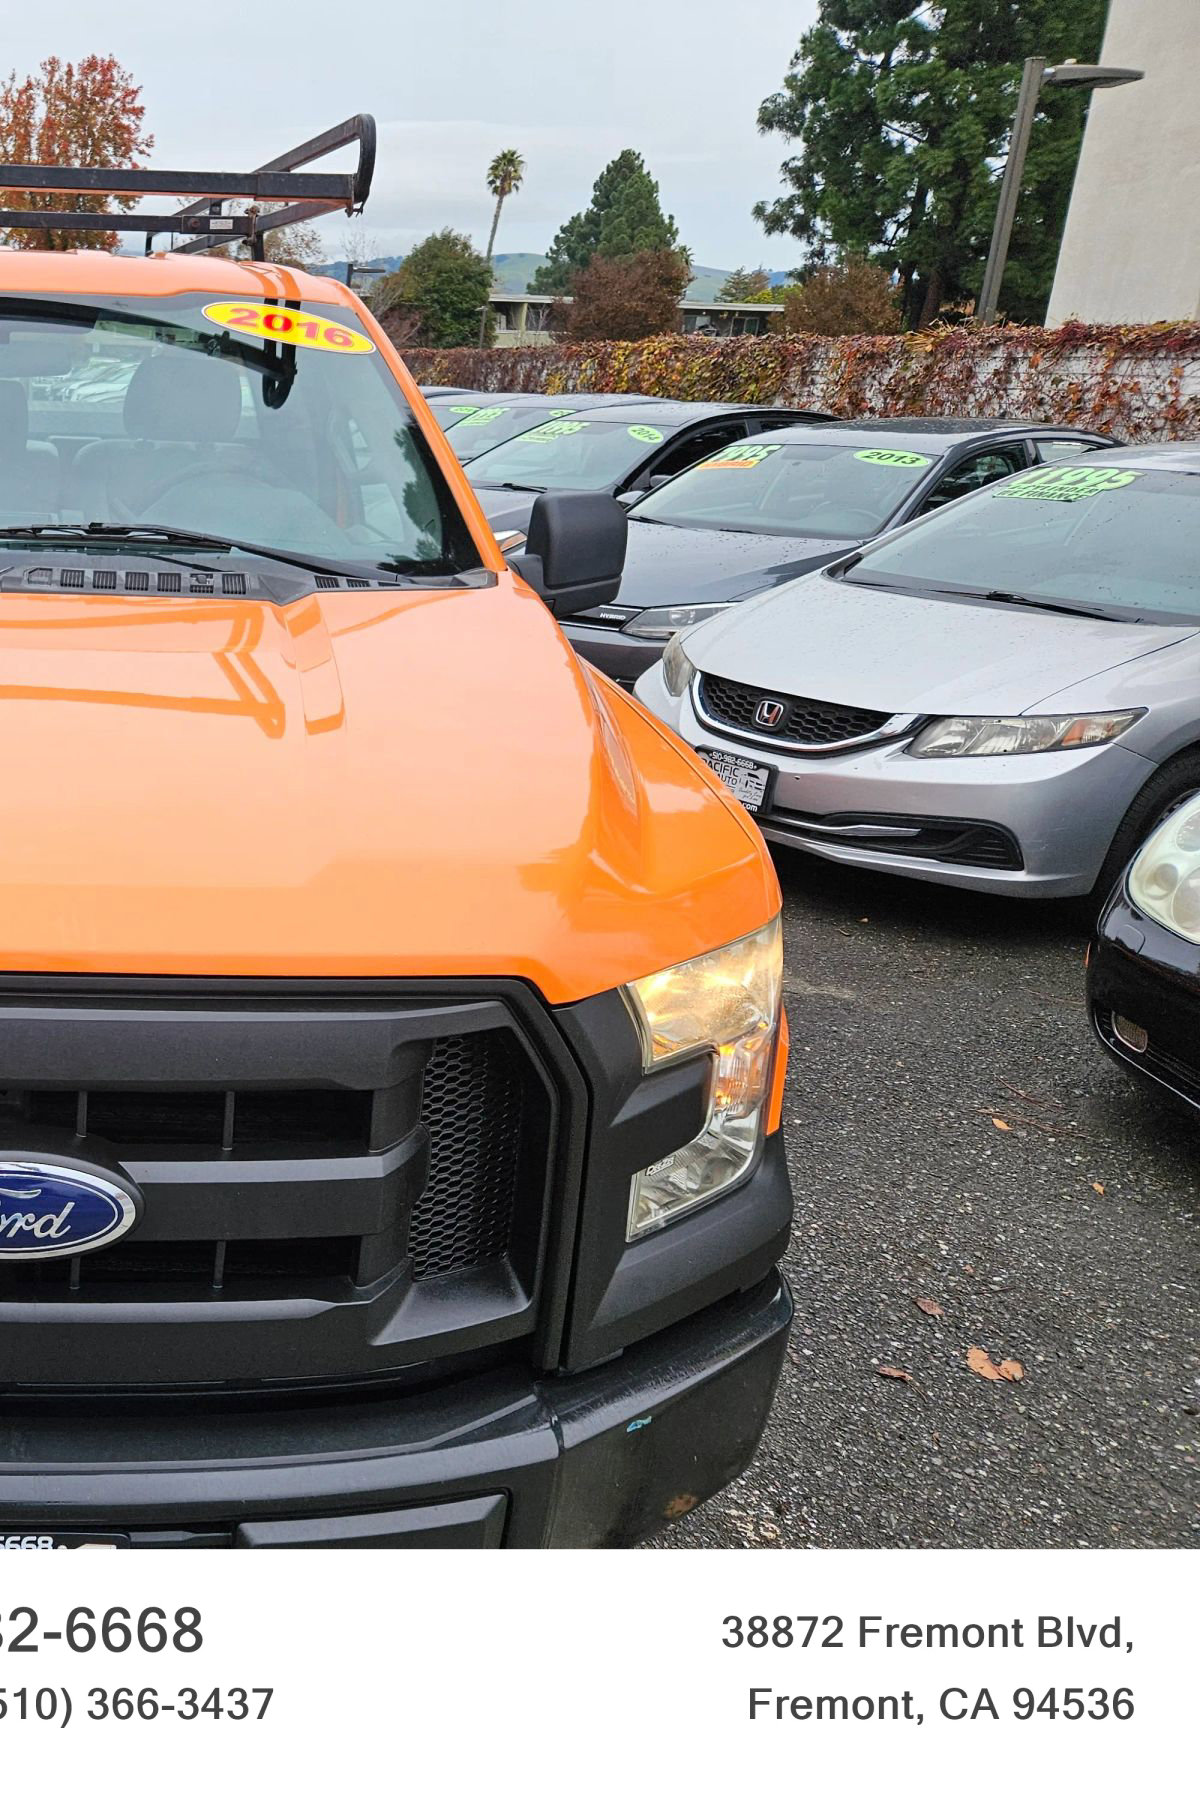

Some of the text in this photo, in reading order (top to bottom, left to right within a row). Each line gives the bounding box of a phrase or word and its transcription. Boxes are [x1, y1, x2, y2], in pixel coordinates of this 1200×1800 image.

[227, 307, 355, 347] 2016
[861, 452, 921, 464] 2013
[1010, 467, 1147, 491] 11995
[599, 612, 627, 620] HYBRID
